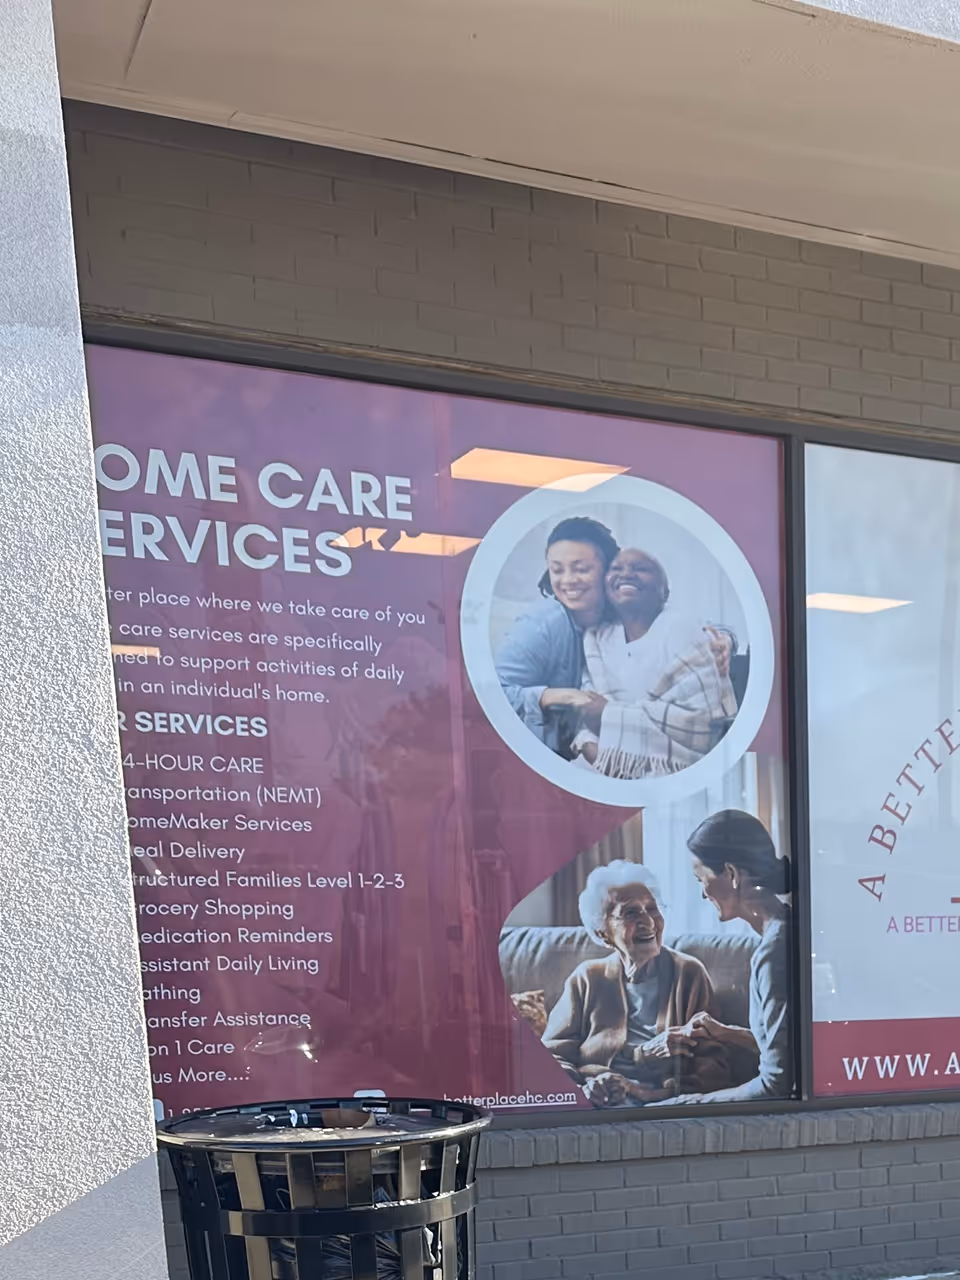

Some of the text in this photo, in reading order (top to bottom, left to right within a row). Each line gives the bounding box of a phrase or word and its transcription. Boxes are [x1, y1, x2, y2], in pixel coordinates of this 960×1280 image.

[258, 462, 413, 521] CARE
[139, 587, 190, 608] place
[196, 593, 252, 611] where
[257, 599, 284, 614] we
[288, 599, 326, 617] take
[331, 606, 369, 621] care
[375, 604, 393, 621] of
[397, 611, 426, 627] you
[119, 623, 162, 637] care
[169, 625, 243, 643] services
[248, 632, 278, 645] are
[284, 631, 383, 656] specifically
[156, 649, 174, 667] to
[180, 656, 250, 676] support
[256, 659, 336, 678] activities
[341, 662, 359, 678] of
[364, 663, 404, 684] daily
[118, 678, 330, 704] in an individual's home.
[134, 711, 268, 737] SERVICES
[209, 756, 264, 774] CARE
[126, 785, 322, 808] ansportation (NEMT)
[234, 814, 312, 832] Services
[130, 840, 245, 864] eal Delivery
[226, 871, 302, 888] Families
[307, 871, 352, 889] Level
[358, 873, 405, 889] 1-2-3
[857, 872, 887, 902] A
[136, 898, 295, 920] rocery Shopping
[139, 926, 333, 944] edication Reminders
[886, 916, 899, 934] A
[217, 955, 263, 975] Daily
[268, 955, 320, 975] Living
[145, 1010, 312, 1028] ansfer Assistance
[175, 1040, 181, 1055] 1
[187, 1039, 235, 1055] Care
